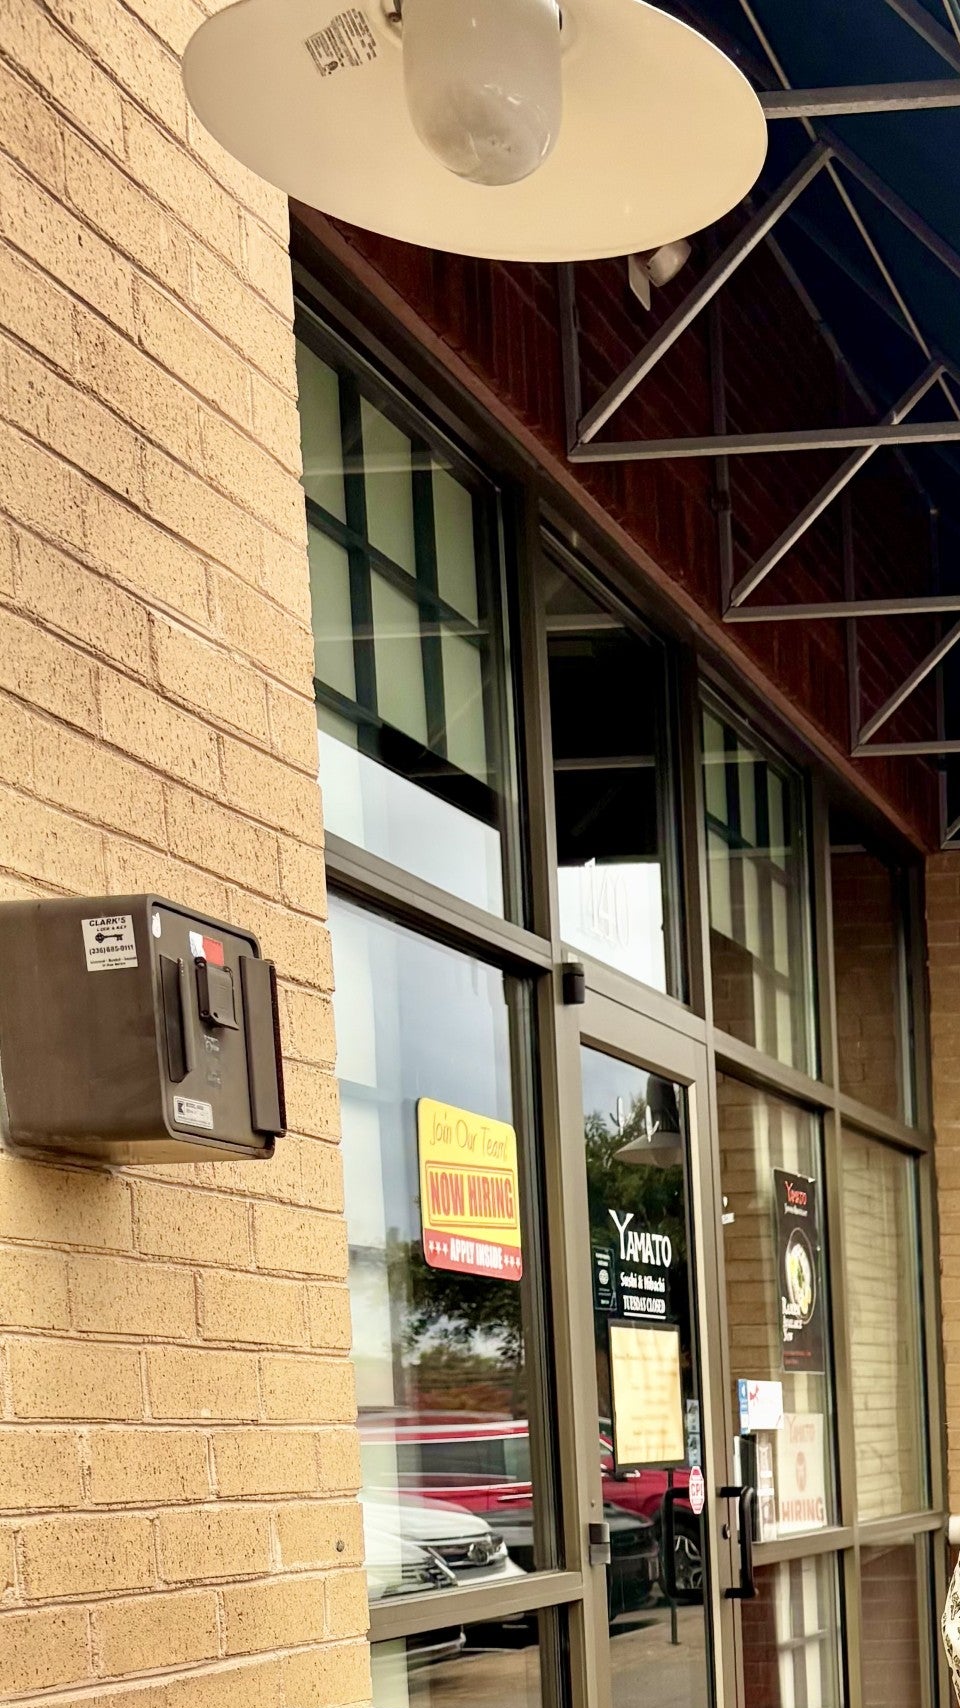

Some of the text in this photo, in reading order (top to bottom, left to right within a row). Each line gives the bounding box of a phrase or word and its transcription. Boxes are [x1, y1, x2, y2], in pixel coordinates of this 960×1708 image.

[89, 917, 126, 927] CLARK'S
[430, 1112, 508, 1162] Join Our Team!
[430, 1171, 514, 1219] NOW HIRING
[608, 1208, 672, 1268] YAMATO
[450, 1237, 503, 1270] APPLY INSIDE
[620, 1271, 666, 1293] Sushi & Hibachi
[646, 1297, 666, 1314] CLOSED
[691, 1483, 703, 1497] CPI
[782, 1497, 824, 1522] HIRING
